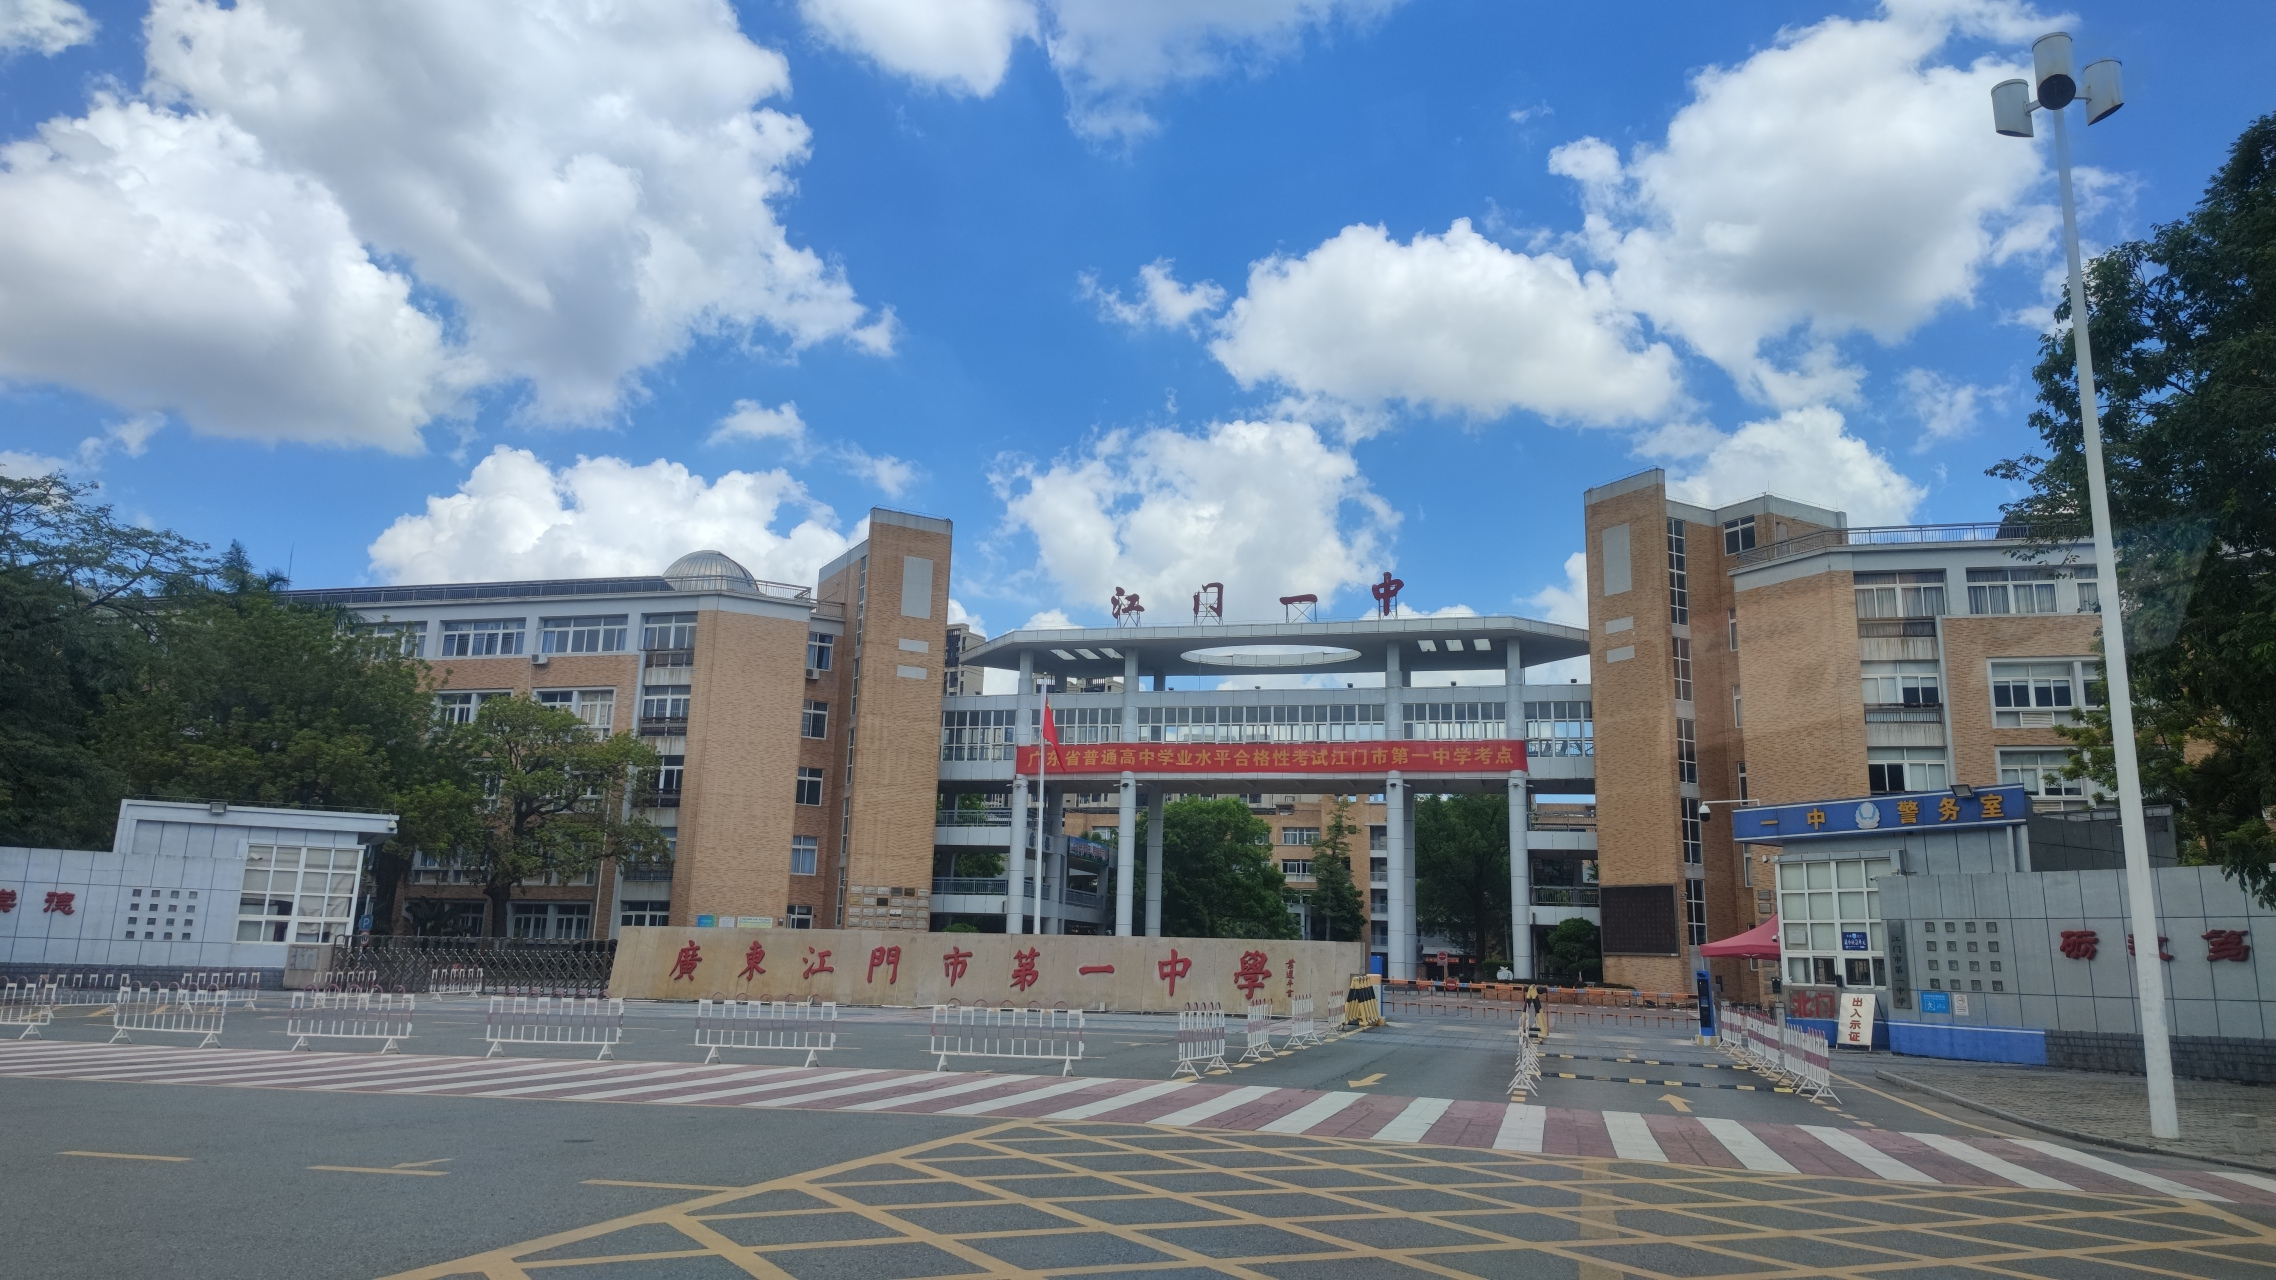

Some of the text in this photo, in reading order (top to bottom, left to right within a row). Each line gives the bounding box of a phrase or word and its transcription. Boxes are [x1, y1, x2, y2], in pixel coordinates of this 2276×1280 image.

[1111, 571, 1404, 619] 江门一中
[1027, 746, 1514, 767] 广东省普通高中学业水平合格性考试江门市第一中学考点
[1760, 793, 2005, 831] 一中 警务室
[363, 918, 370, 928] P
[669, 940, 1273, 1000] 廣東江門市第一中學
[1891, 935, 1906, 1006] 江门市第一中学
[1791, 991, 1836, 1018] 北门
[1848, 997, 1863, 1042] 出入示证
